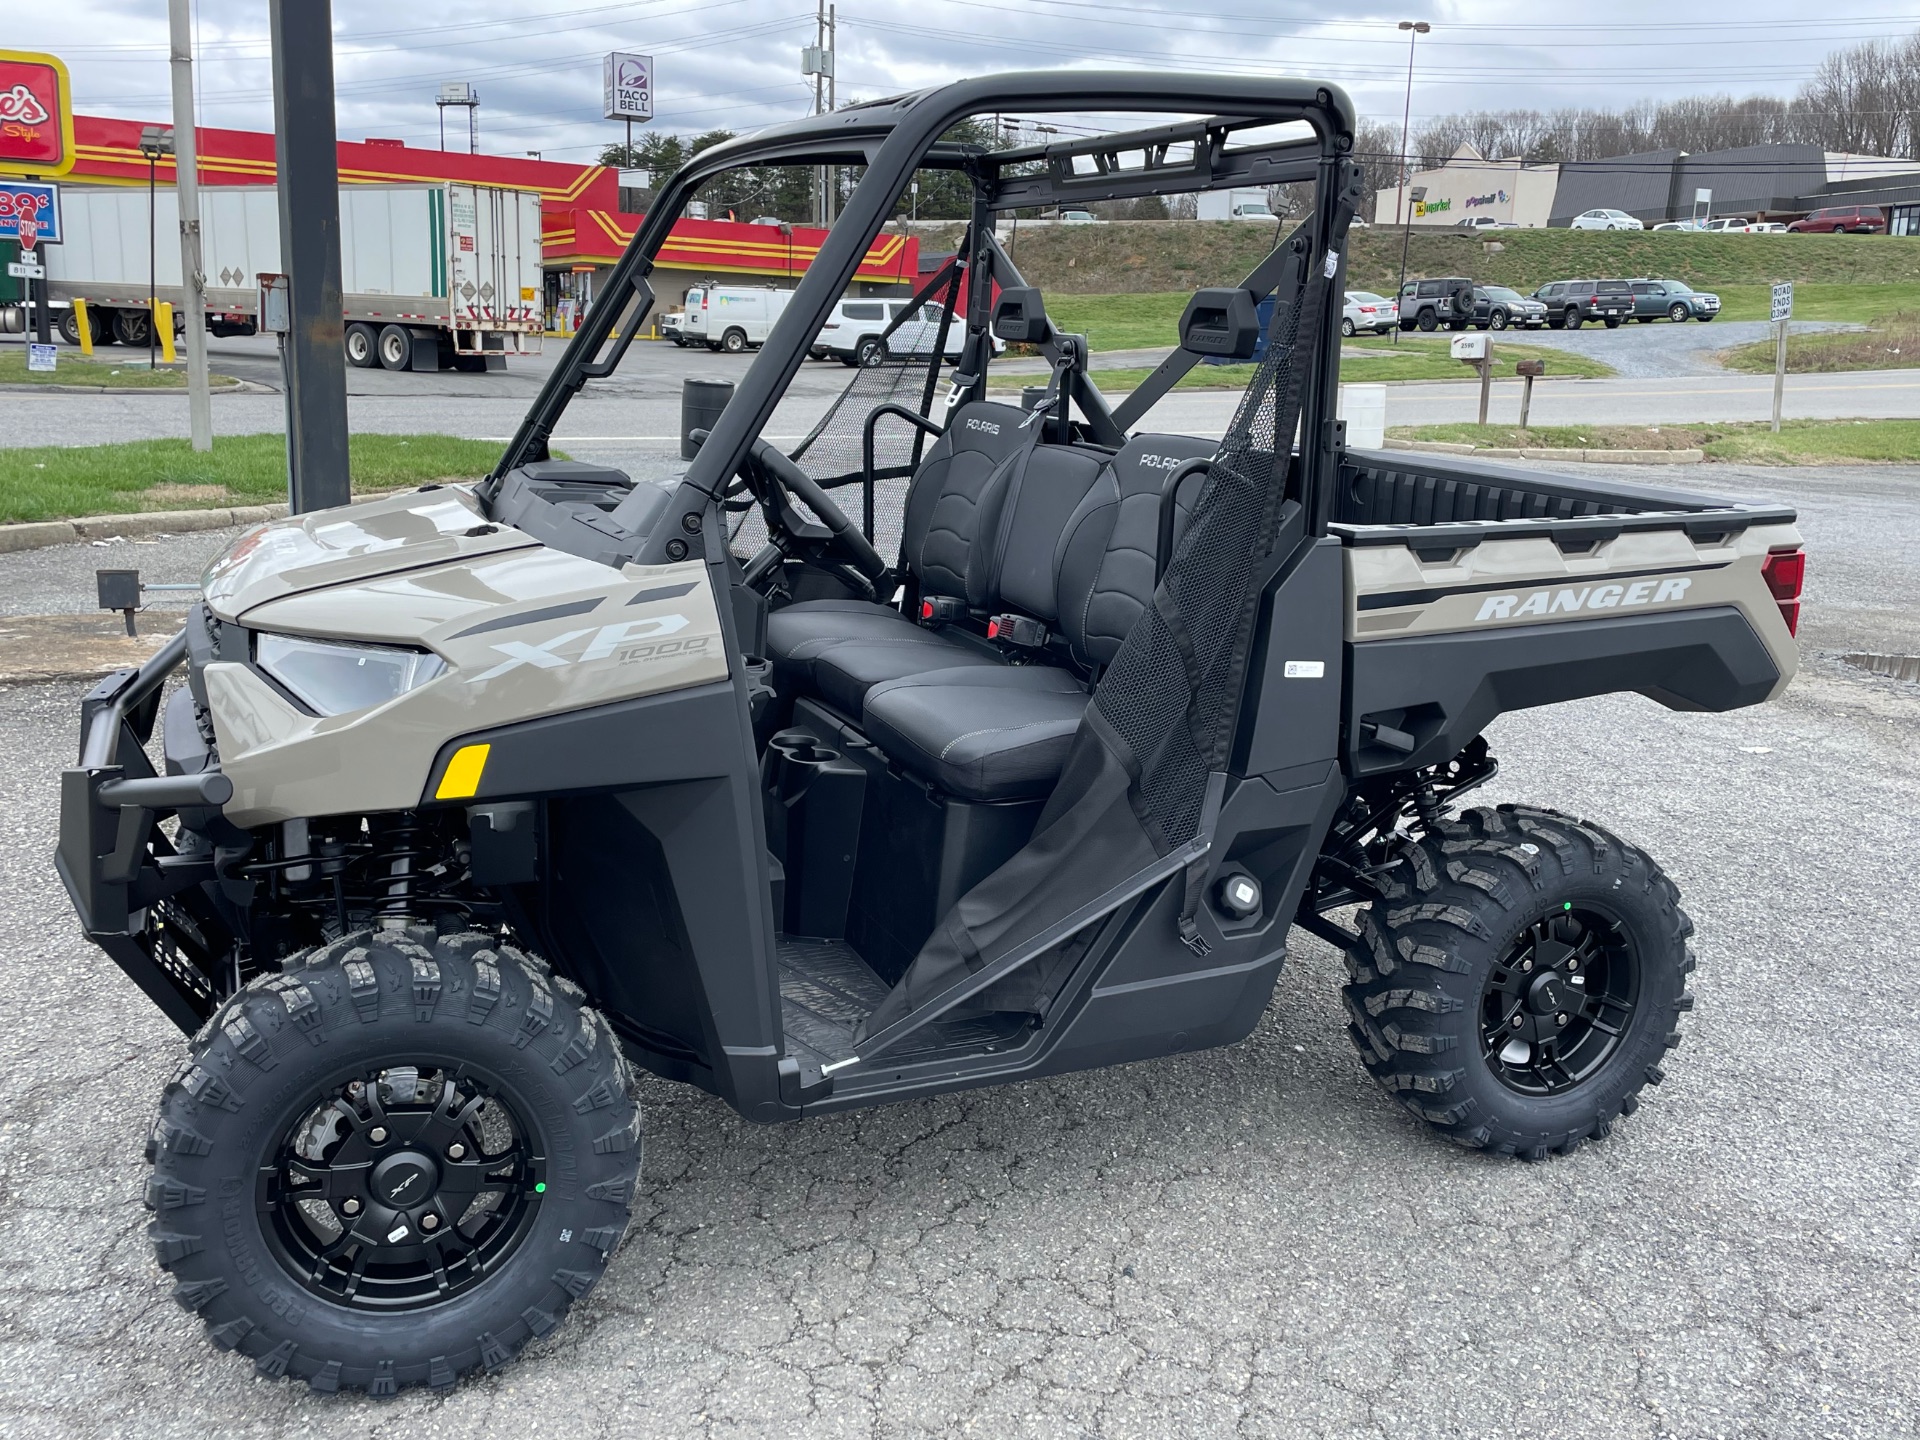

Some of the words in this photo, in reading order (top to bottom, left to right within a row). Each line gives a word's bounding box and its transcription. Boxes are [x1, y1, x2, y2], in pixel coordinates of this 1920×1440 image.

[617, 89, 649, 101] TACO
[620, 100, 648, 112] BELL
[4, 124, 41, 142] Style
[1425, 198, 1451, 213] market
[20, 219, 36, 237] STOP
[1773, 285, 1791, 297] ROAD
[1773, 296, 1791, 307] ENDS
[965, 418, 1001, 436] POLARIS
[1139, 454, 1184, 471] POLAR
[1474, 577, 1692, 621] RANGER
[463, 613, 691, 684] XP
[618, 636, 710, 662] 1000
[222, 1199, 265, 1287] ARMOR
[256, 1282, 307, 1327] PRO
